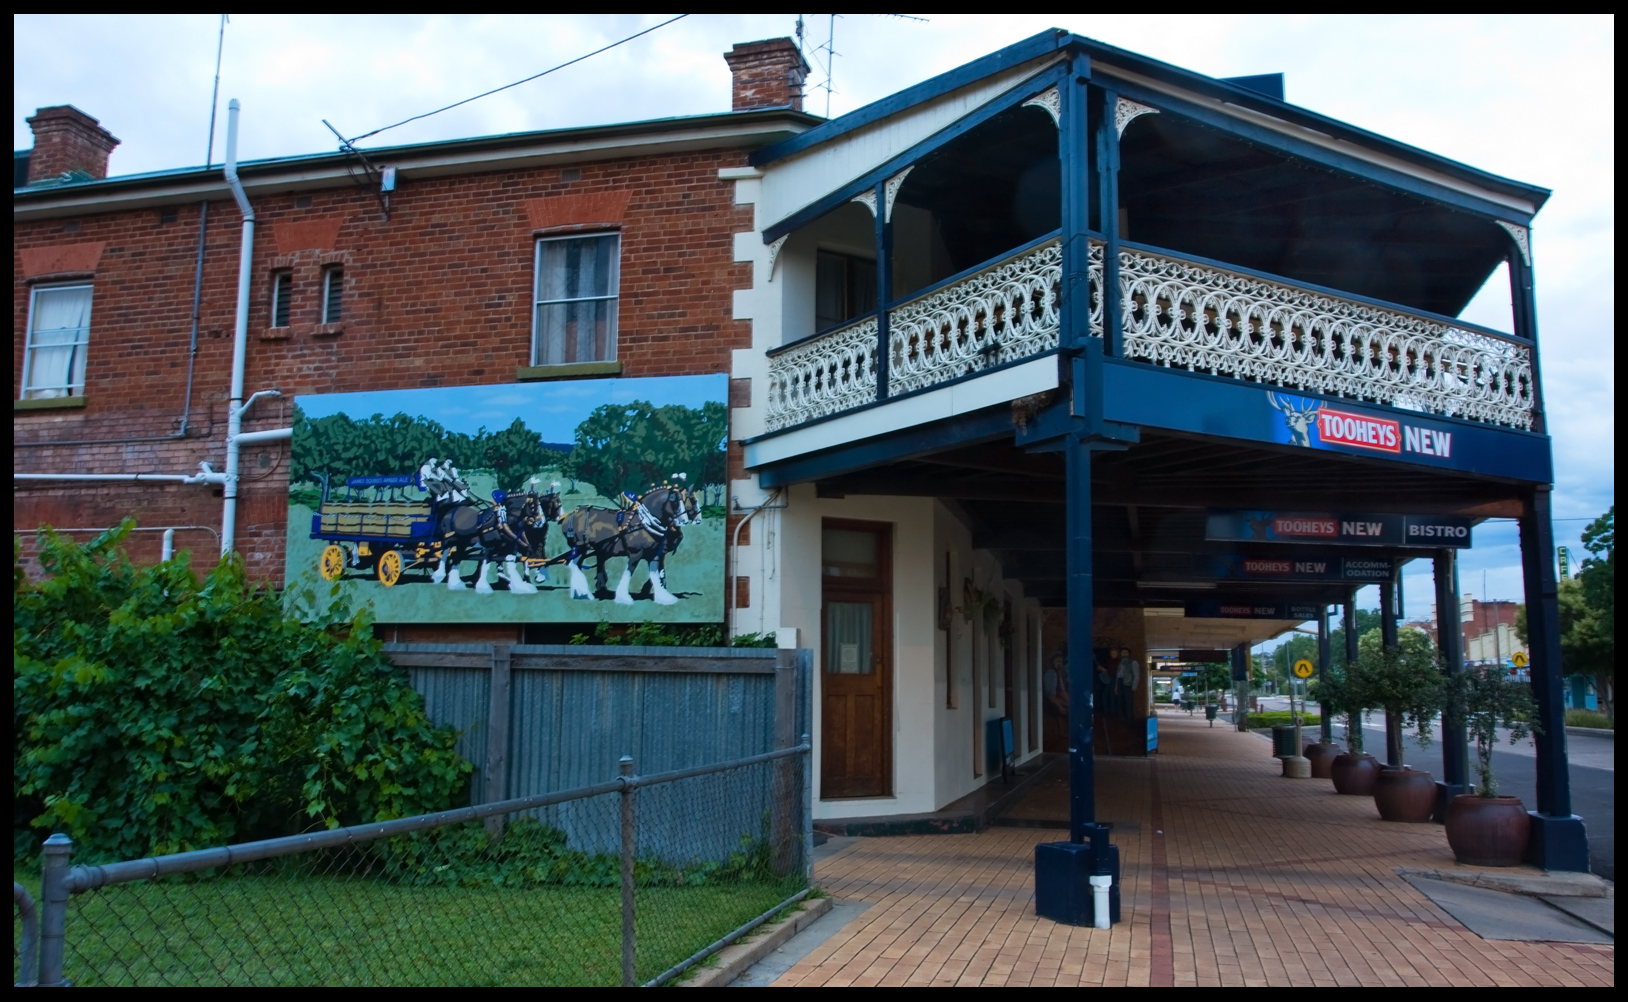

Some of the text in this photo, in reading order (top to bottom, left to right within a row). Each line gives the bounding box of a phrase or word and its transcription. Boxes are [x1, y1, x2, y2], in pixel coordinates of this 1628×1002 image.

[1321, 414, 1451, 458] TOOHEYS NEW
[1275, 519, 1383, 536] TOOHEYS NEW
[1409, 524, 1468, 538] BISTRO
[1245, 561, 1327, 573] TOOHEYS NEW
[1345, 561, 1392, 569] ACCOMM-
[1346, 569, 1390, 578] ODATION
[1220, 606, 1276, 615] TOOHEYS NEW
